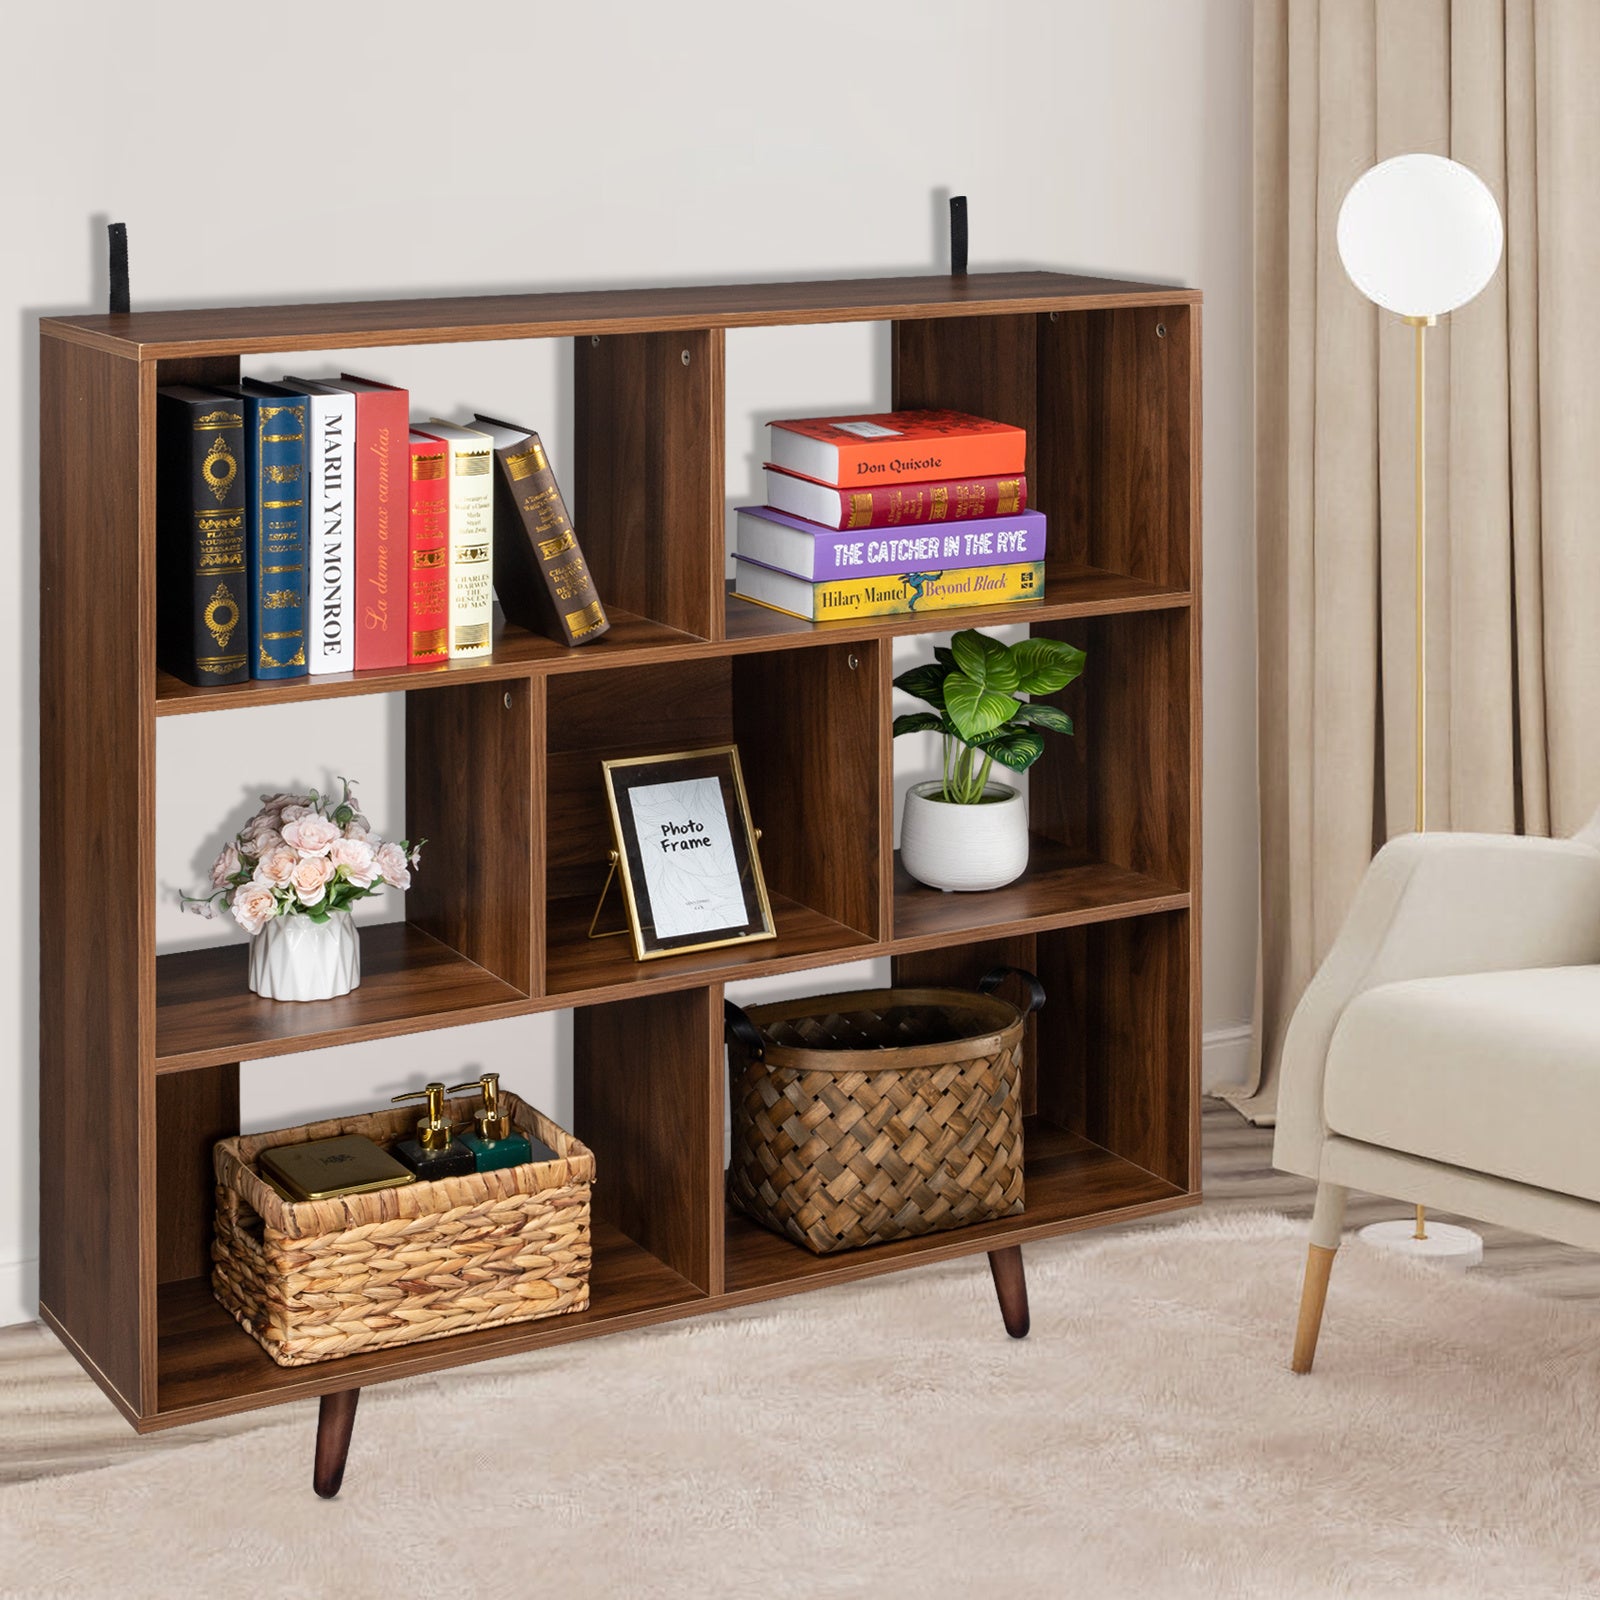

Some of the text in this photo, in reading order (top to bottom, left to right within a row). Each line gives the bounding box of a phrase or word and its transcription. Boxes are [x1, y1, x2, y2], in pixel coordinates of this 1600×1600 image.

[857, 456, 943, 475] Don Quixote
[323, 414, 343, 656] MARILYN MONROE
[364, 428, 390, 632] La dame aux camelias
[833, 529, 1029, 567] THE CATCHER IN THE RYE
[821, 572, 1009, 610] Hilary Mantel Beyond Black
[660, 837, 712, 853] Frame
[661, 820, 704, 836] Photo
